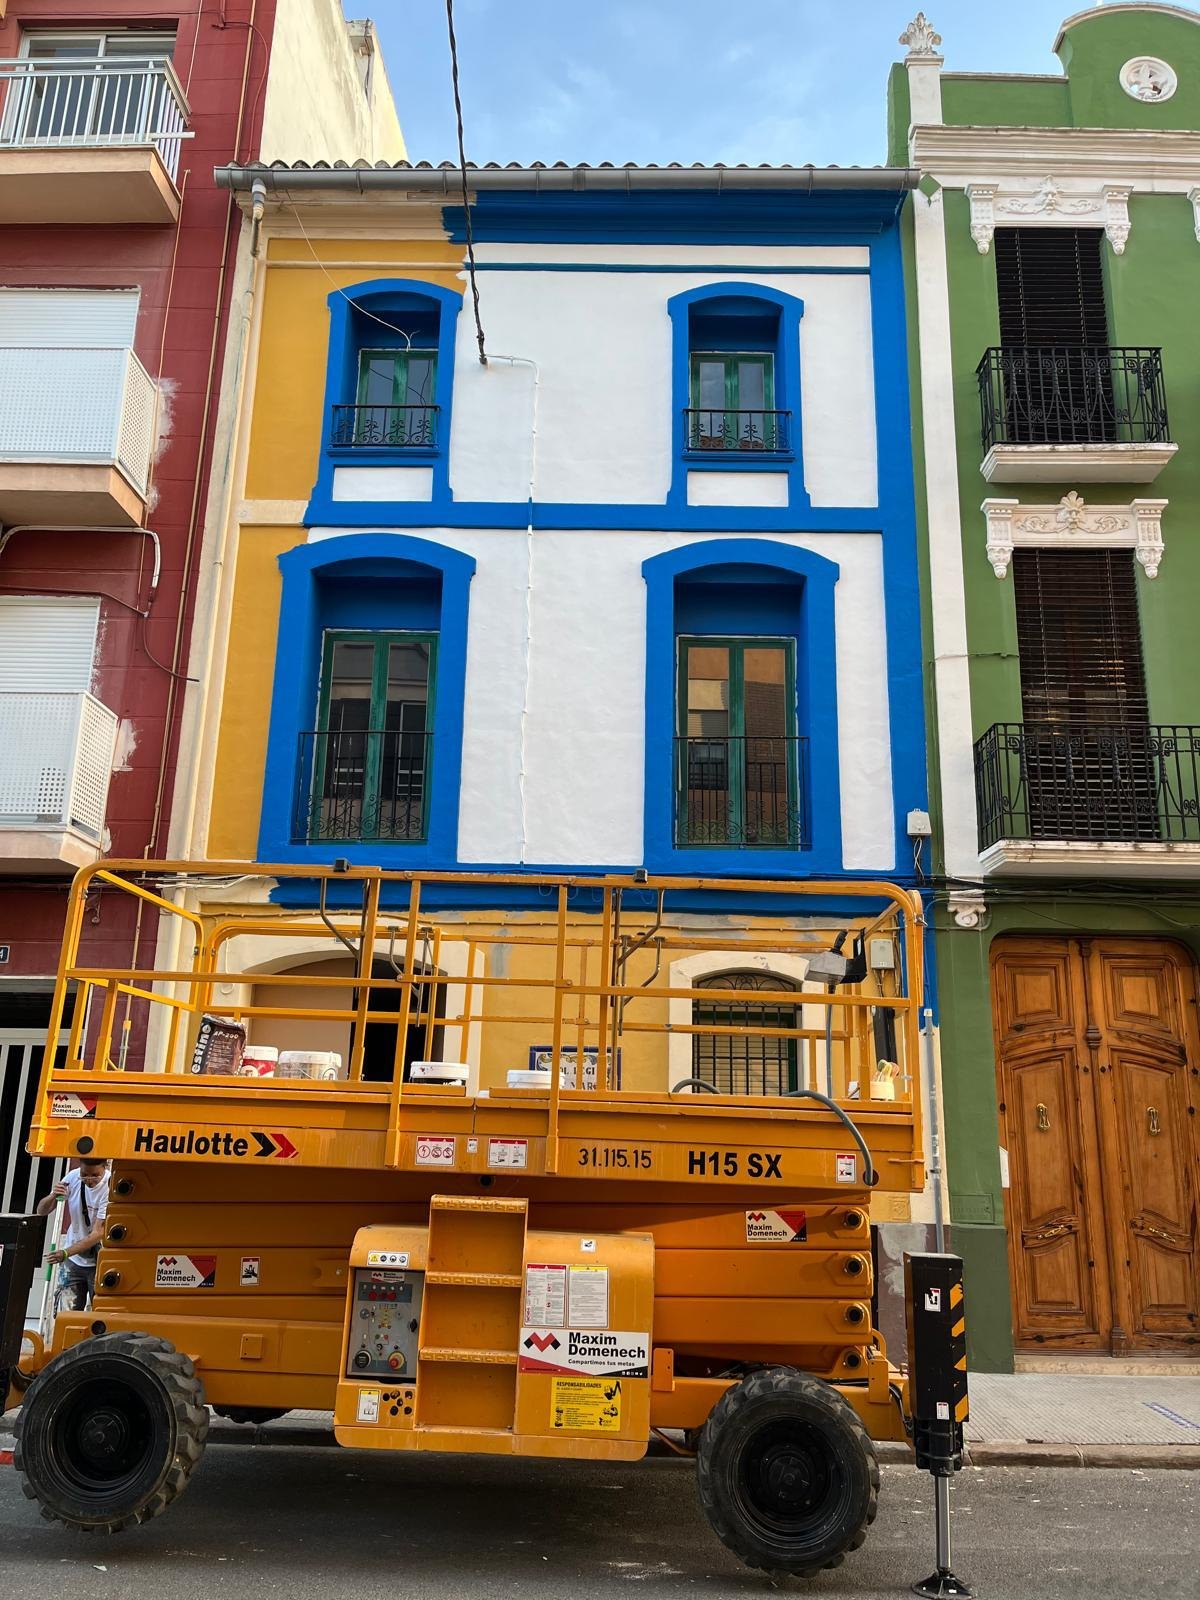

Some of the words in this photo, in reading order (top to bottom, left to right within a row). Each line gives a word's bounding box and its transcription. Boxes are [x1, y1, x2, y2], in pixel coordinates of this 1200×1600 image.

[134, 1128, 249, 1157] Haulotte
[578, 1147, 652, 1169] 31.115.15
[688, 1151, 738, 1177] H15
[747, 1153, 783, 1179] SX
[156, 1274, 196, 1283] Domenech
[157, 1268, 182, 1276] Maxim
[568, 1331, 617, 1346] Maxim
[568, 1343, 646, 1359] Domenech
